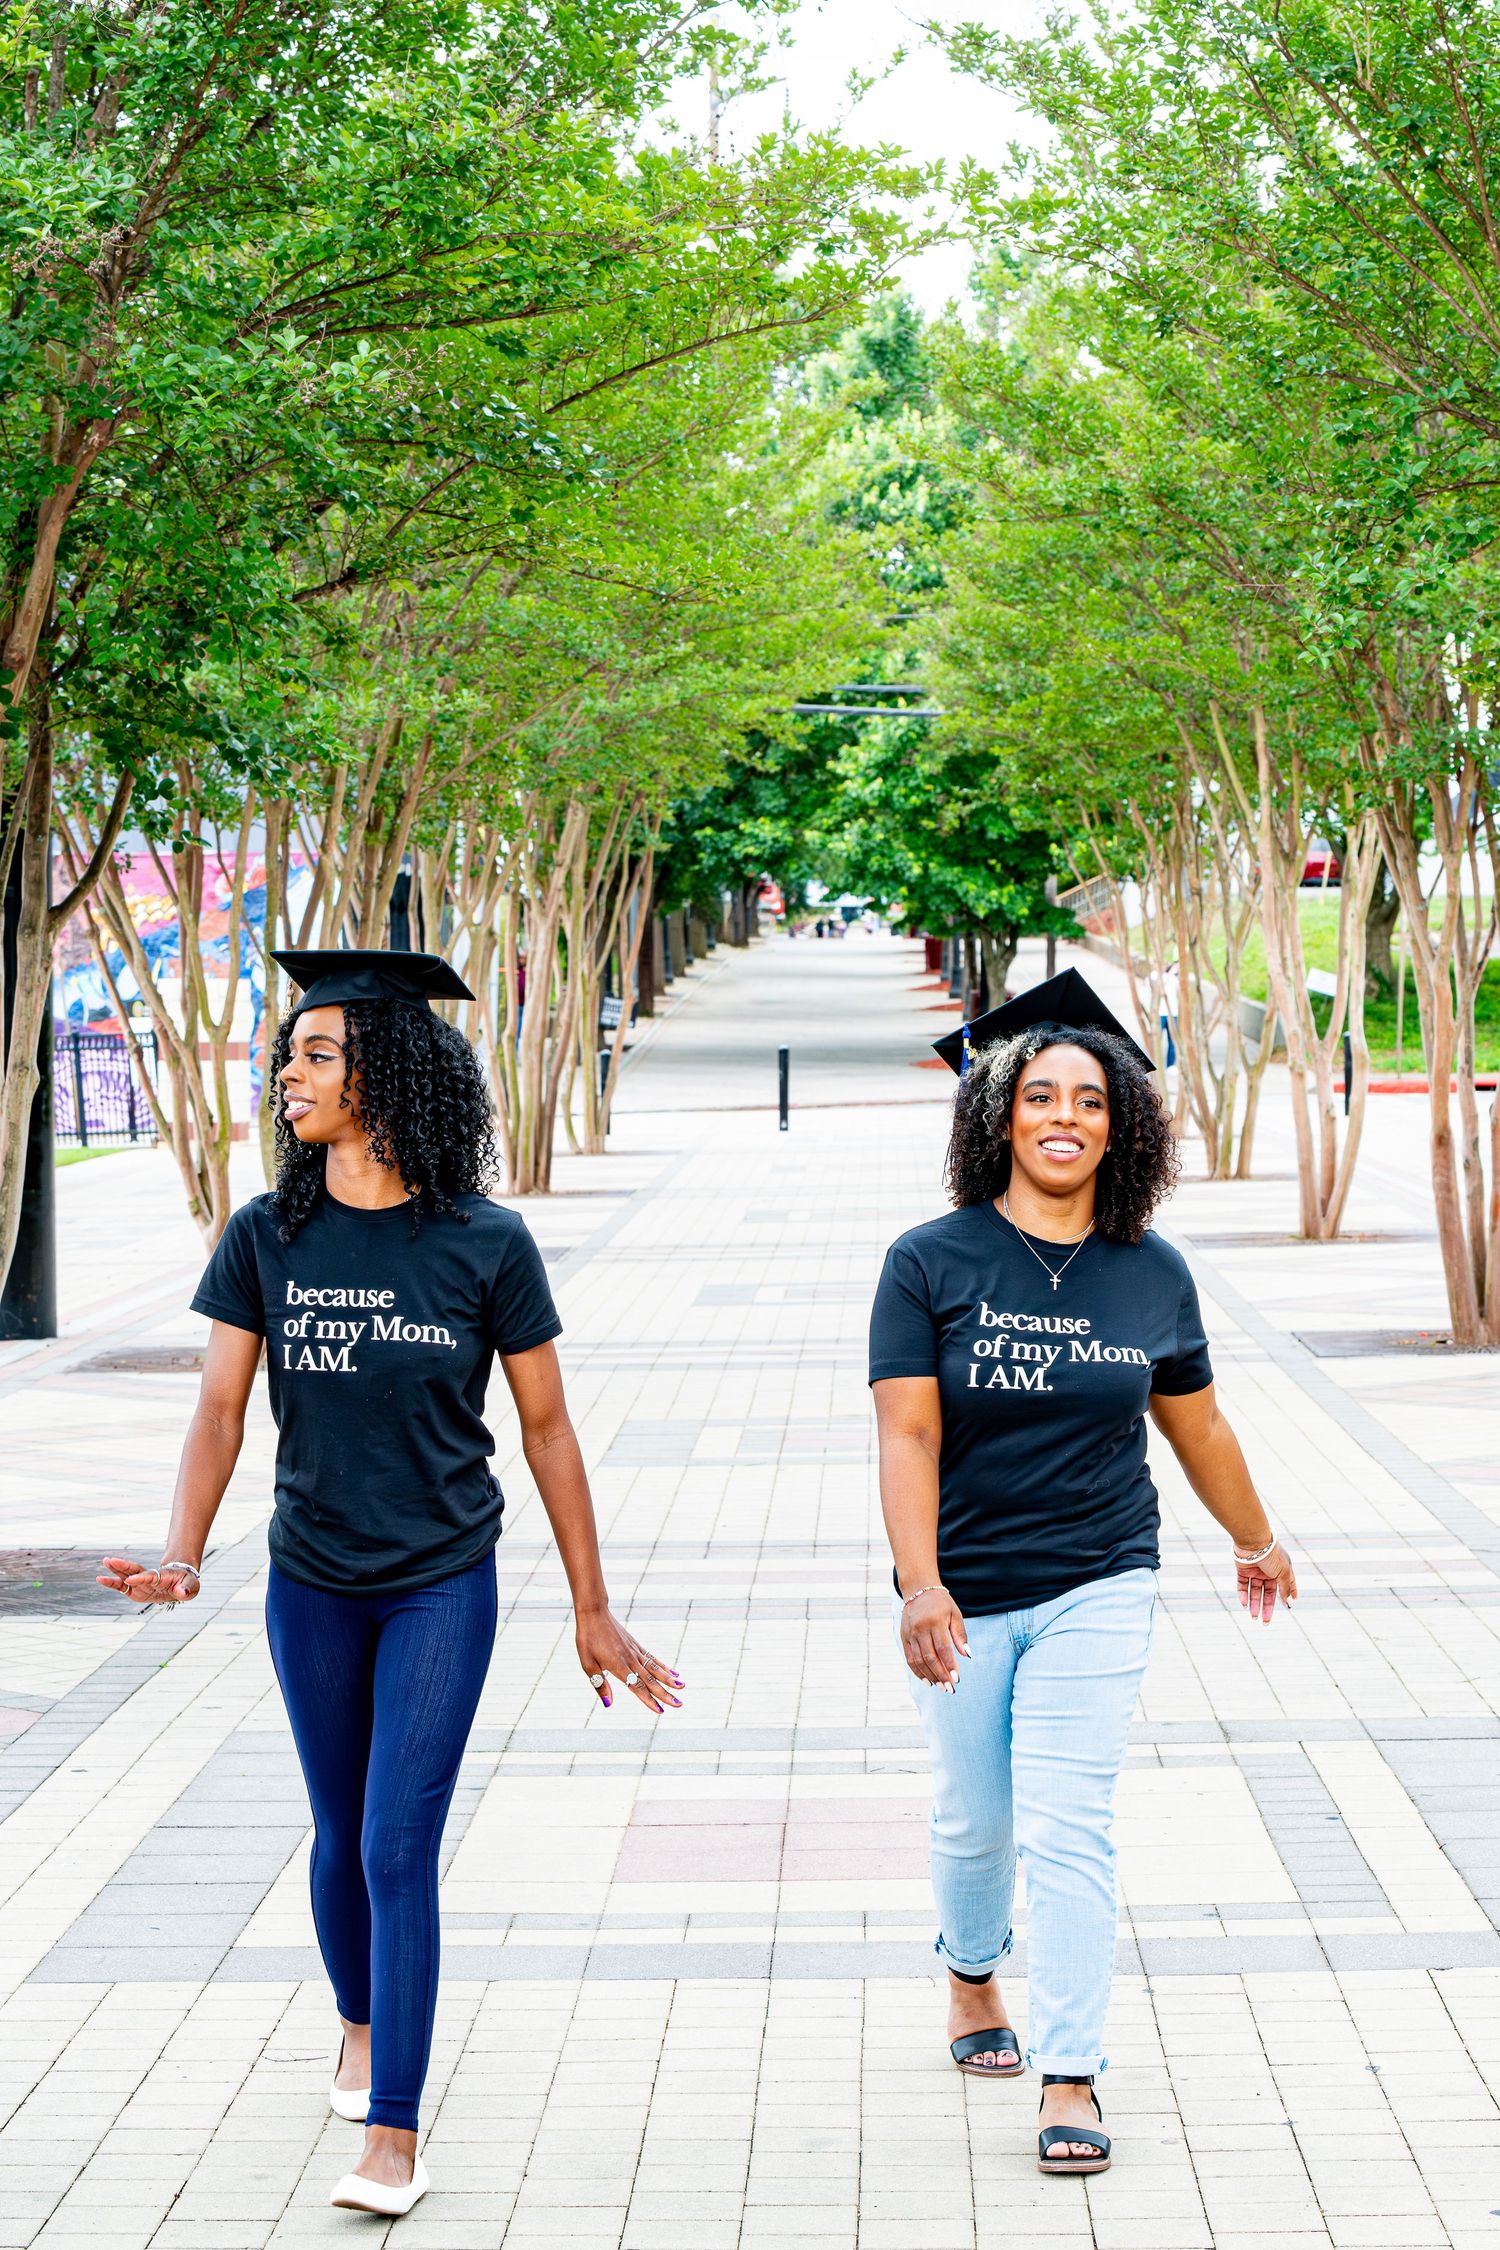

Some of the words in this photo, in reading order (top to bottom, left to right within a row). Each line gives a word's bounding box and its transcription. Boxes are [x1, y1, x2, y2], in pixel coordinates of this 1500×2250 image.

[286, 1280, 395, 1309] because
[283, 1311, 316, 1338] of
[314, 1319, 368, 1347] my
[370, 1315, 458, 1350] Mom,
[979, 1301, 1091, 1335] because
[282, 1344, 293, 1370] I
[294, 1344, 358, 1373] AM.
[973, 1333, 1011, 1358] of
[1009, 1341, 1064, 1368] my
[1067, 1340, 1153, 1370] Mom,
[966, 1362, 981, 1388] I
[984, 1364, 1054, 1392] AM.
